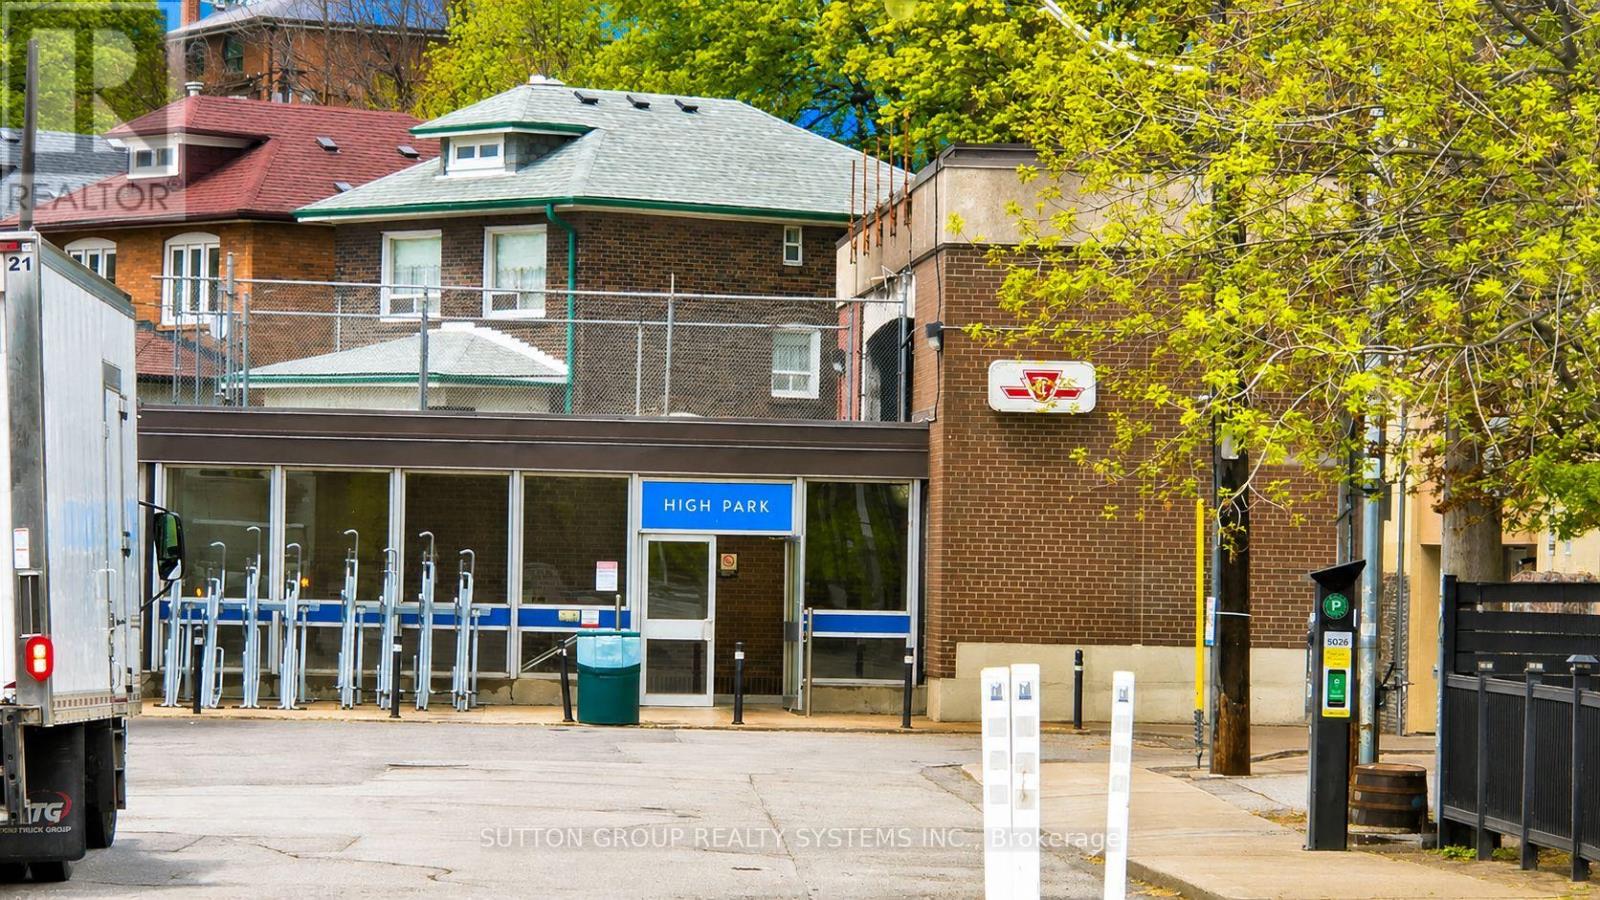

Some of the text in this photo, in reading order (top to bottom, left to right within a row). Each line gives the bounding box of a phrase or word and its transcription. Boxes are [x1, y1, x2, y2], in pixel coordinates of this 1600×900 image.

[8, 256, 31, 272] 21
[664, 498, 769, 513] HIGH PARK
[1331, 600, 1342, 611] P
[1327, 638, 1349, 646] 5026
